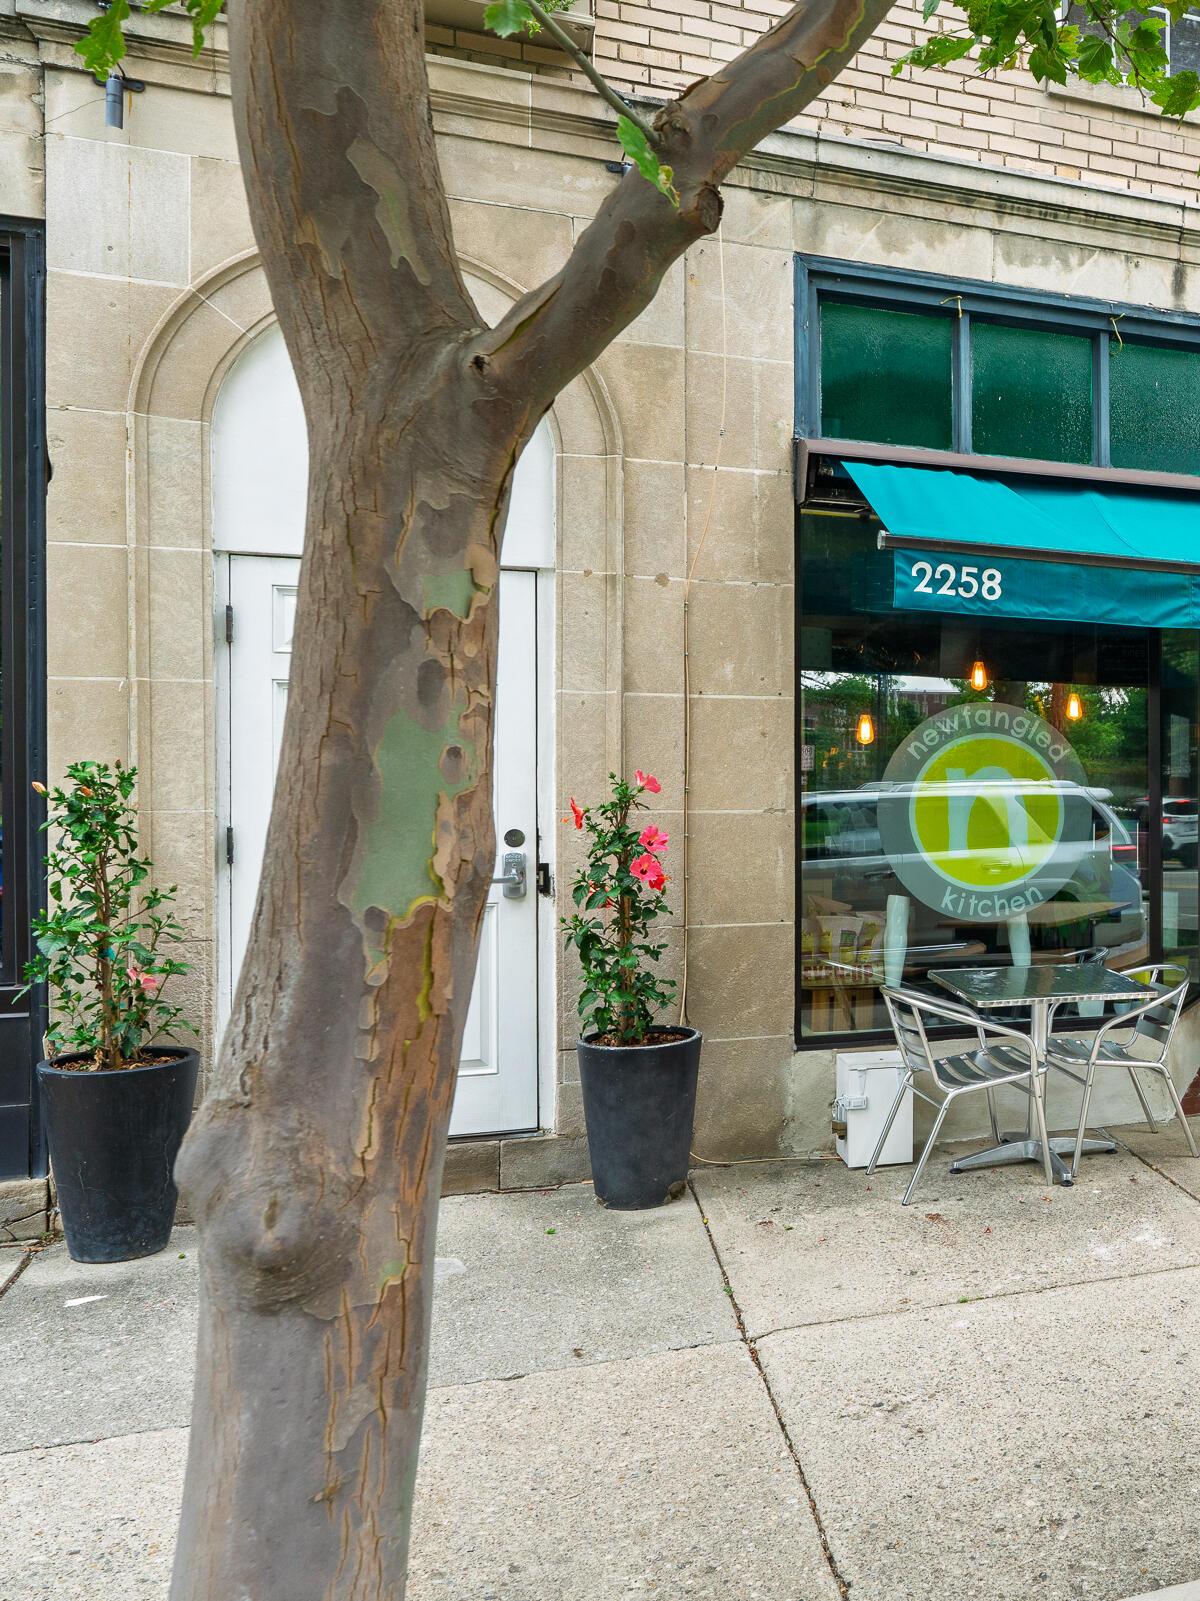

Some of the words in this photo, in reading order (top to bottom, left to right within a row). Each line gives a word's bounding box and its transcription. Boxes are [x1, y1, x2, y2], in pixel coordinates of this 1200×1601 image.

[912, 561, 1002, 601] 2258
[906, 705, 1072, 764] newfangled
[945, 765, 1030, 858] n
[940, 886, 1044, 918] kitchen
